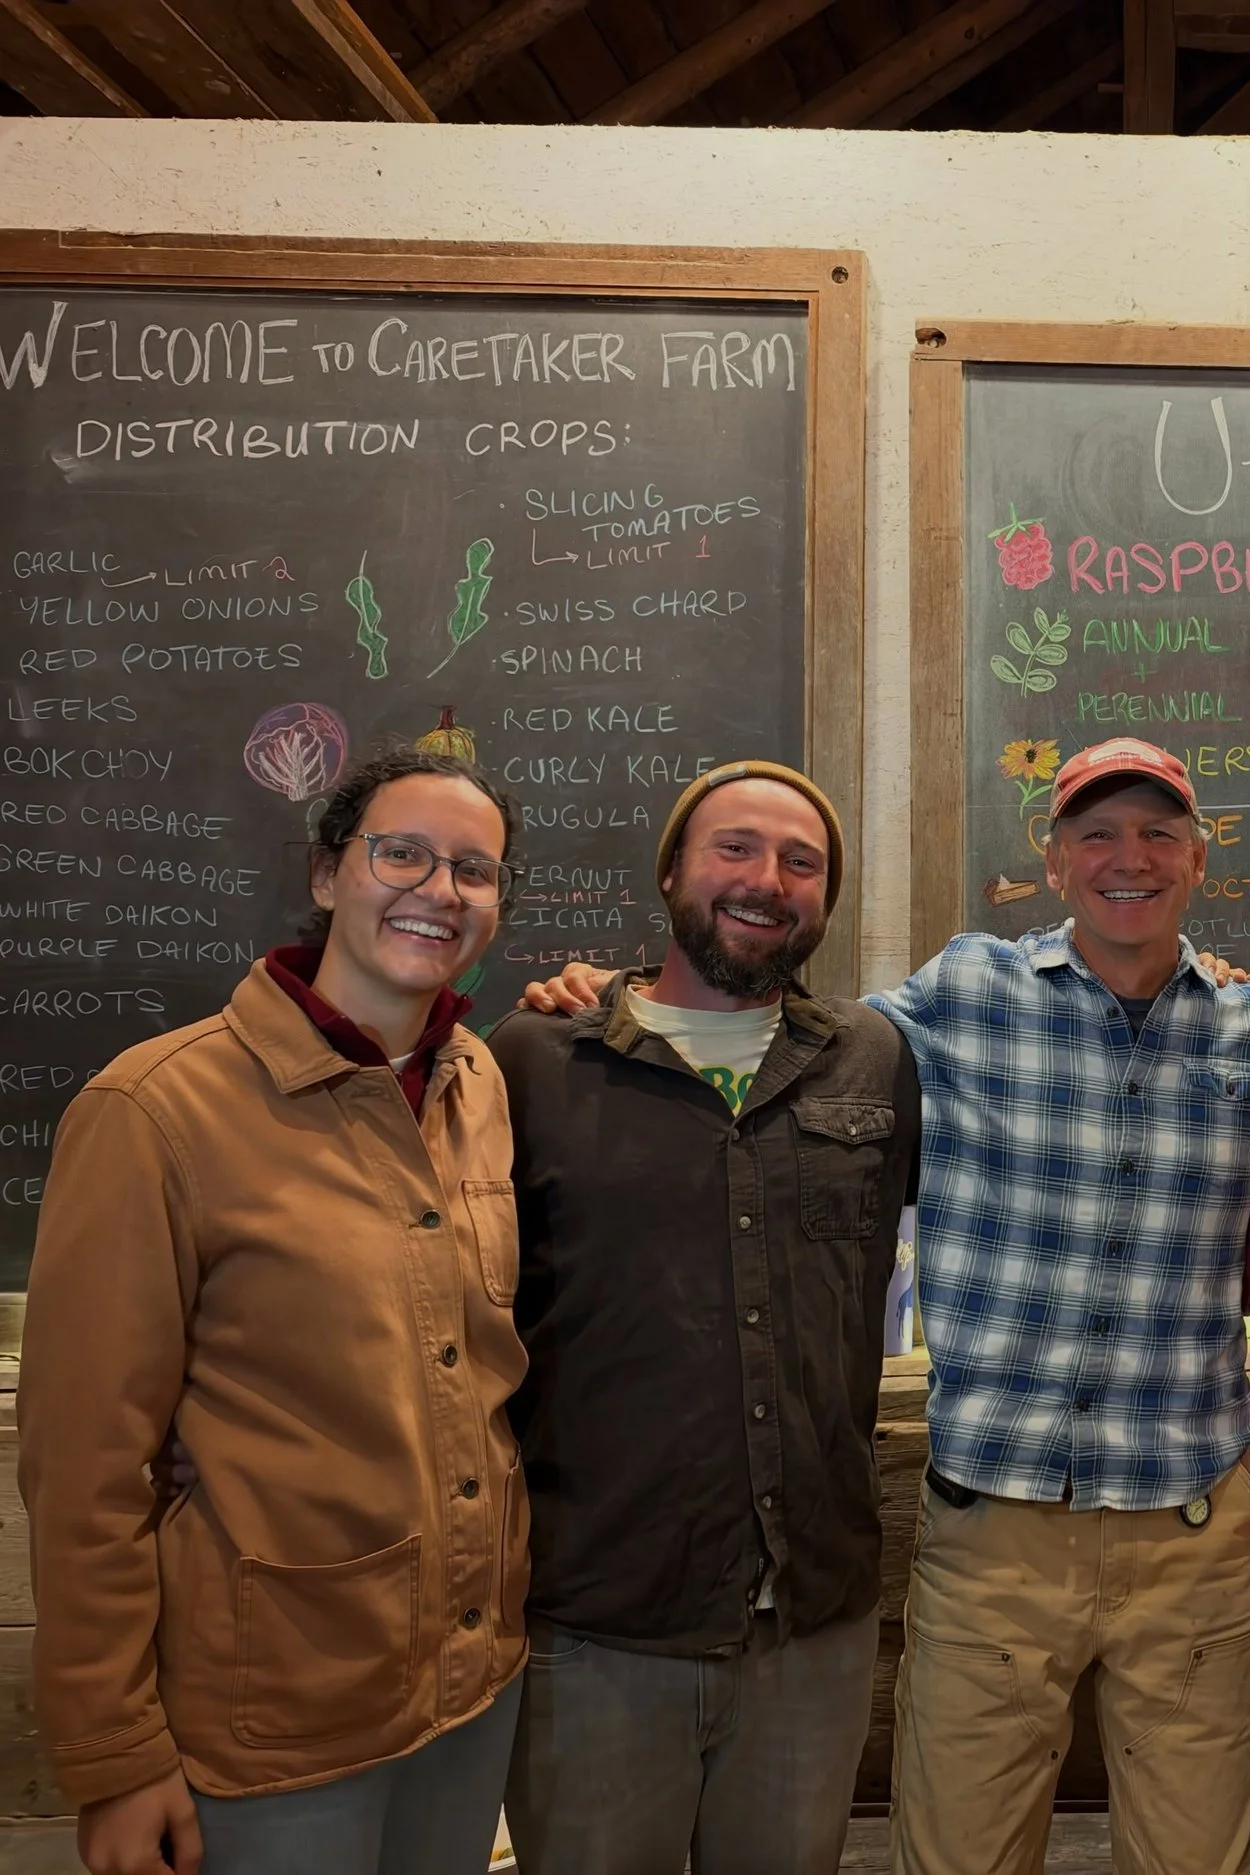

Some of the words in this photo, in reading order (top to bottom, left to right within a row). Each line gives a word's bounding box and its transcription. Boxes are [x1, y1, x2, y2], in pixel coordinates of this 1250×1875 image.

[0, 301, 298, 390] WELCOME
[312, 341, 355, 373] TO
[367, 318, 636, 386] CARETAKER
[661, 331, 796, 392] FARM
[76, 417, 419, 461] DISTRIBUTION
[466, 420, 632, 456] CROPS:
[526, 484, 664, 521] SLICING
[581, 496, 761, 542] TOMATOES
[13, 551, 121, 579] GARLIC
[587, 541, 671, 570] LIMIT
[696, 535, 711, 558] 1
[164, 560, 259, 586] LIMIT
[263, 556, 296, 582] 2
[20, 597, 159, 626] YELLOW
[181, 592, 320, 621] ONIONS
[516, 597, 615, 625] SWISS
[632, 589, 747, 618] CHARD
[1083, 616, 1229, 655] ANNUAL
[19, 648, 98, 676] RED
[121, 643, 303, 675] POTATOES
[499, 645, 642, 675] SPINACH
[8, 695, 138, 723] LEEKS
[503, 706, 572, 732] RED
[587, 704, 679, 733] KALE
[1077, 691, 1243, 723] PERENNIAL
[3, 746, 76, 780] BOK
[80, 748, 173, 782] CHOY
[503, 753, 606, 785] CURLY
[0, 801, 67, 825] RED
[80, 804, 234, 840] CABBAGE
[0, 844, 101, 878] GREEN
[117, 854, 262, 896] CABBAGE
[551, 890, 608, 904] LIMIT
[620, 889, 637, 905] 1
[0, 900, 91, 922] WHITE
[105, 904, 218, 927] DAIKON
[0, 938, 118, 958] PURPLE
[137, 940, 254, 963] DAIKON
[539, 948, 620, 964] LIMIT
[0, 1064, 74, 1093] RED
